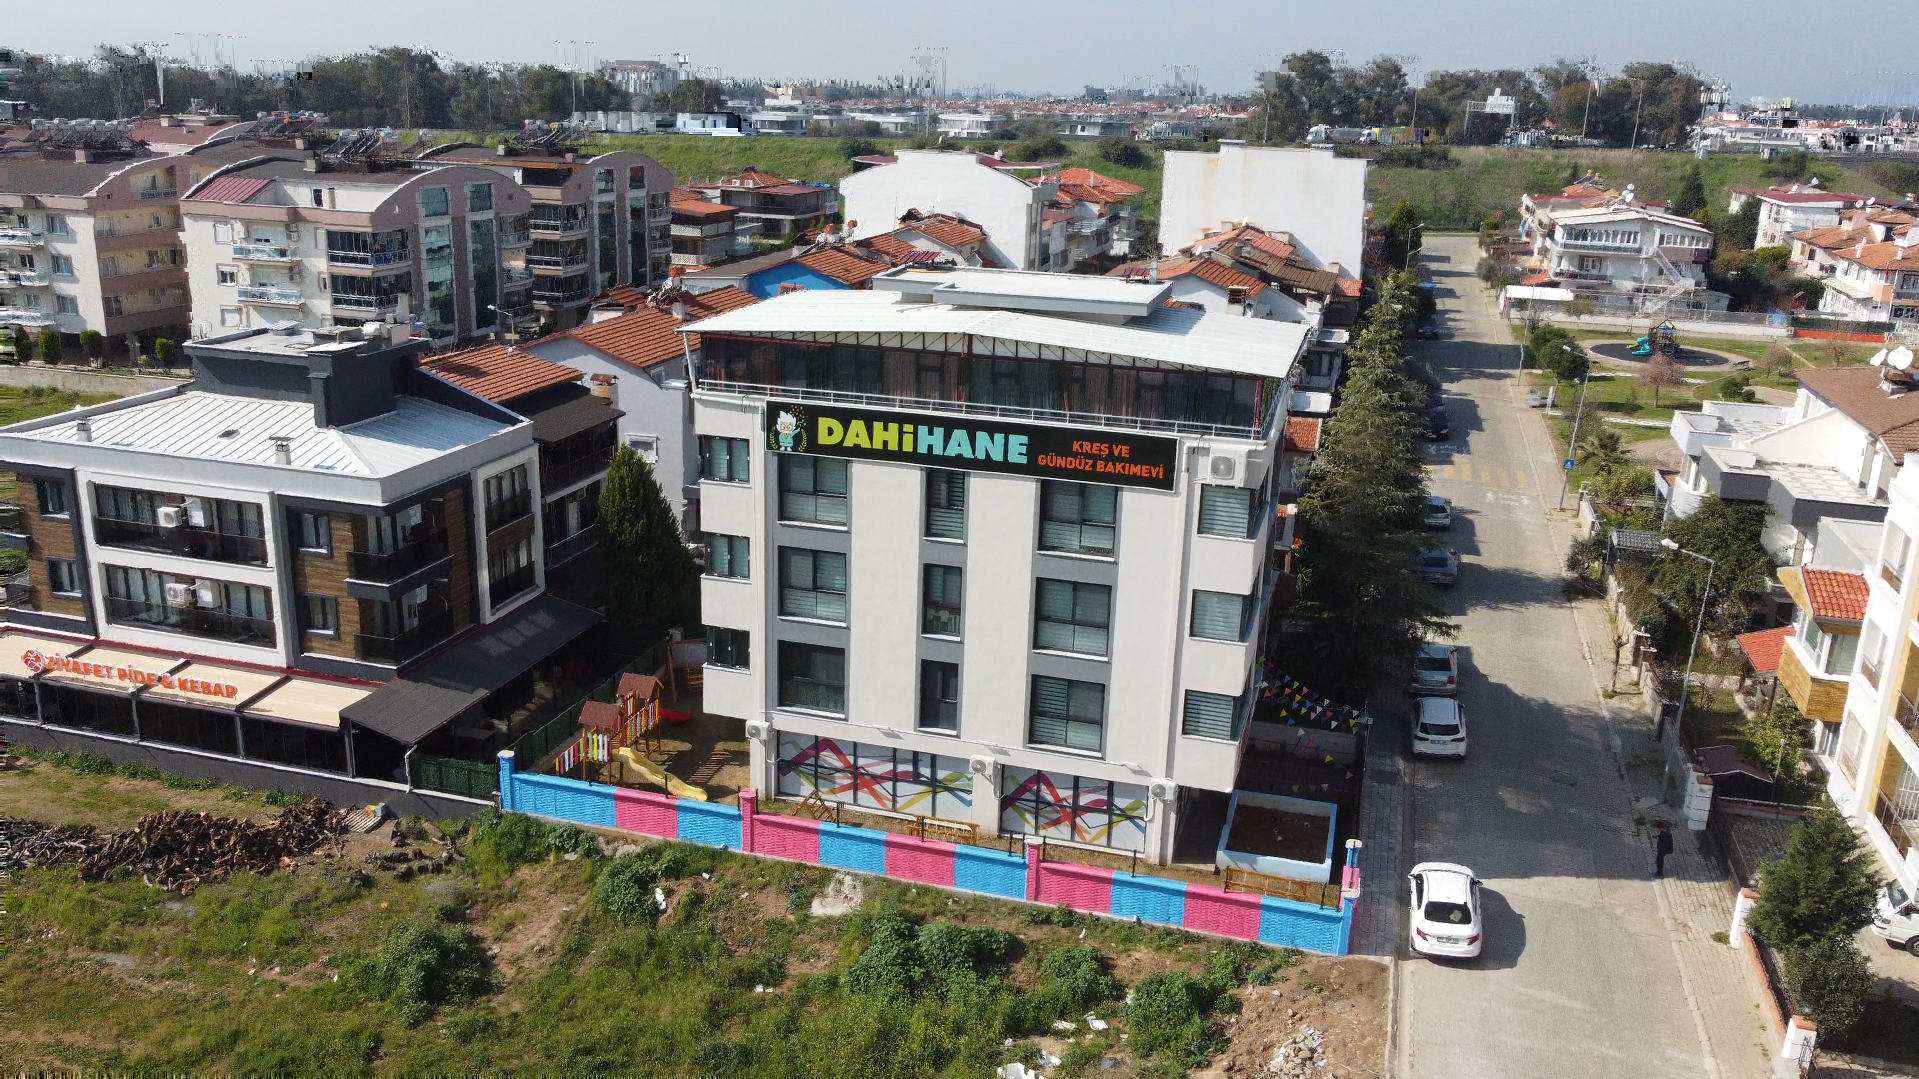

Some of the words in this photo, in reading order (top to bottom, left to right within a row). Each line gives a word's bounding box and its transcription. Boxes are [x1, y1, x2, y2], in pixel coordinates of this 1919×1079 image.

[1072, 440, 1109, 458] KREŞ
[1112, 444, 1131, 458] VE
[1037, 452, 1093, 471] GÜNDÜZ
[1096, 460, 1164, 479] BAKIMEVİ
[45, 652, 113, 679] ZİYAFET
[117, 665, 157, 688] PİDE
[161, 673, 175, 690] &
[178, 677, 238, 698] KEBAP
